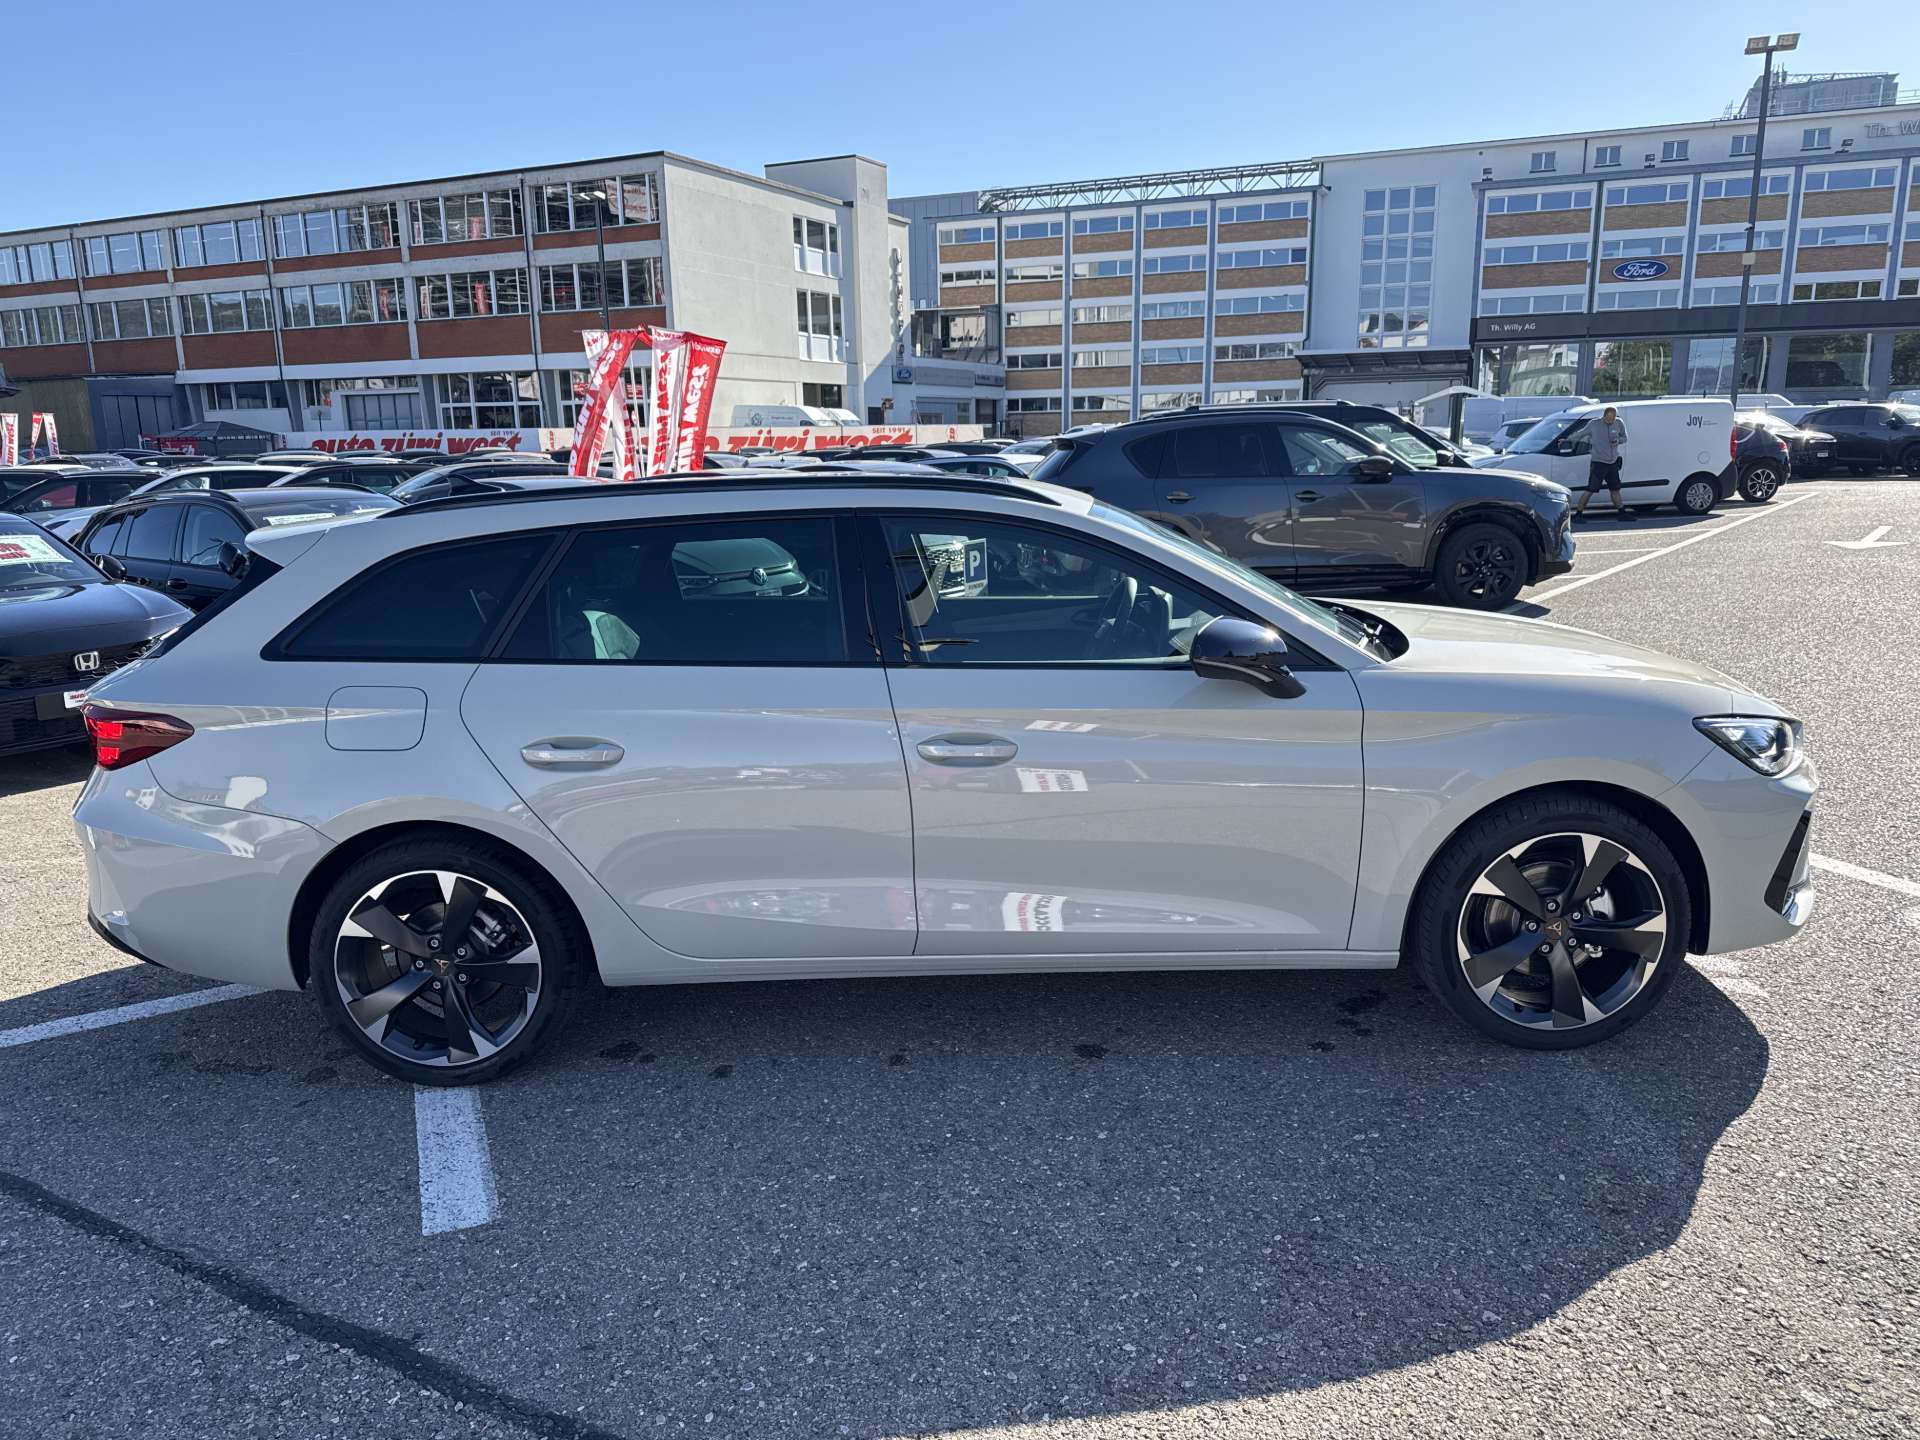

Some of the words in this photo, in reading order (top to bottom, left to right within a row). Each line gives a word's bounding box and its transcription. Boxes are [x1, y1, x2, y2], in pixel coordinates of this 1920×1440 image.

[1623, 263, 1657, 277] Ford
[1503, 322, 1523, 333] Willy
[1524, 322, 1536, 330] AG
[1686, 414, 1704, 428] Joy
[969, 550, 981, 577] P
